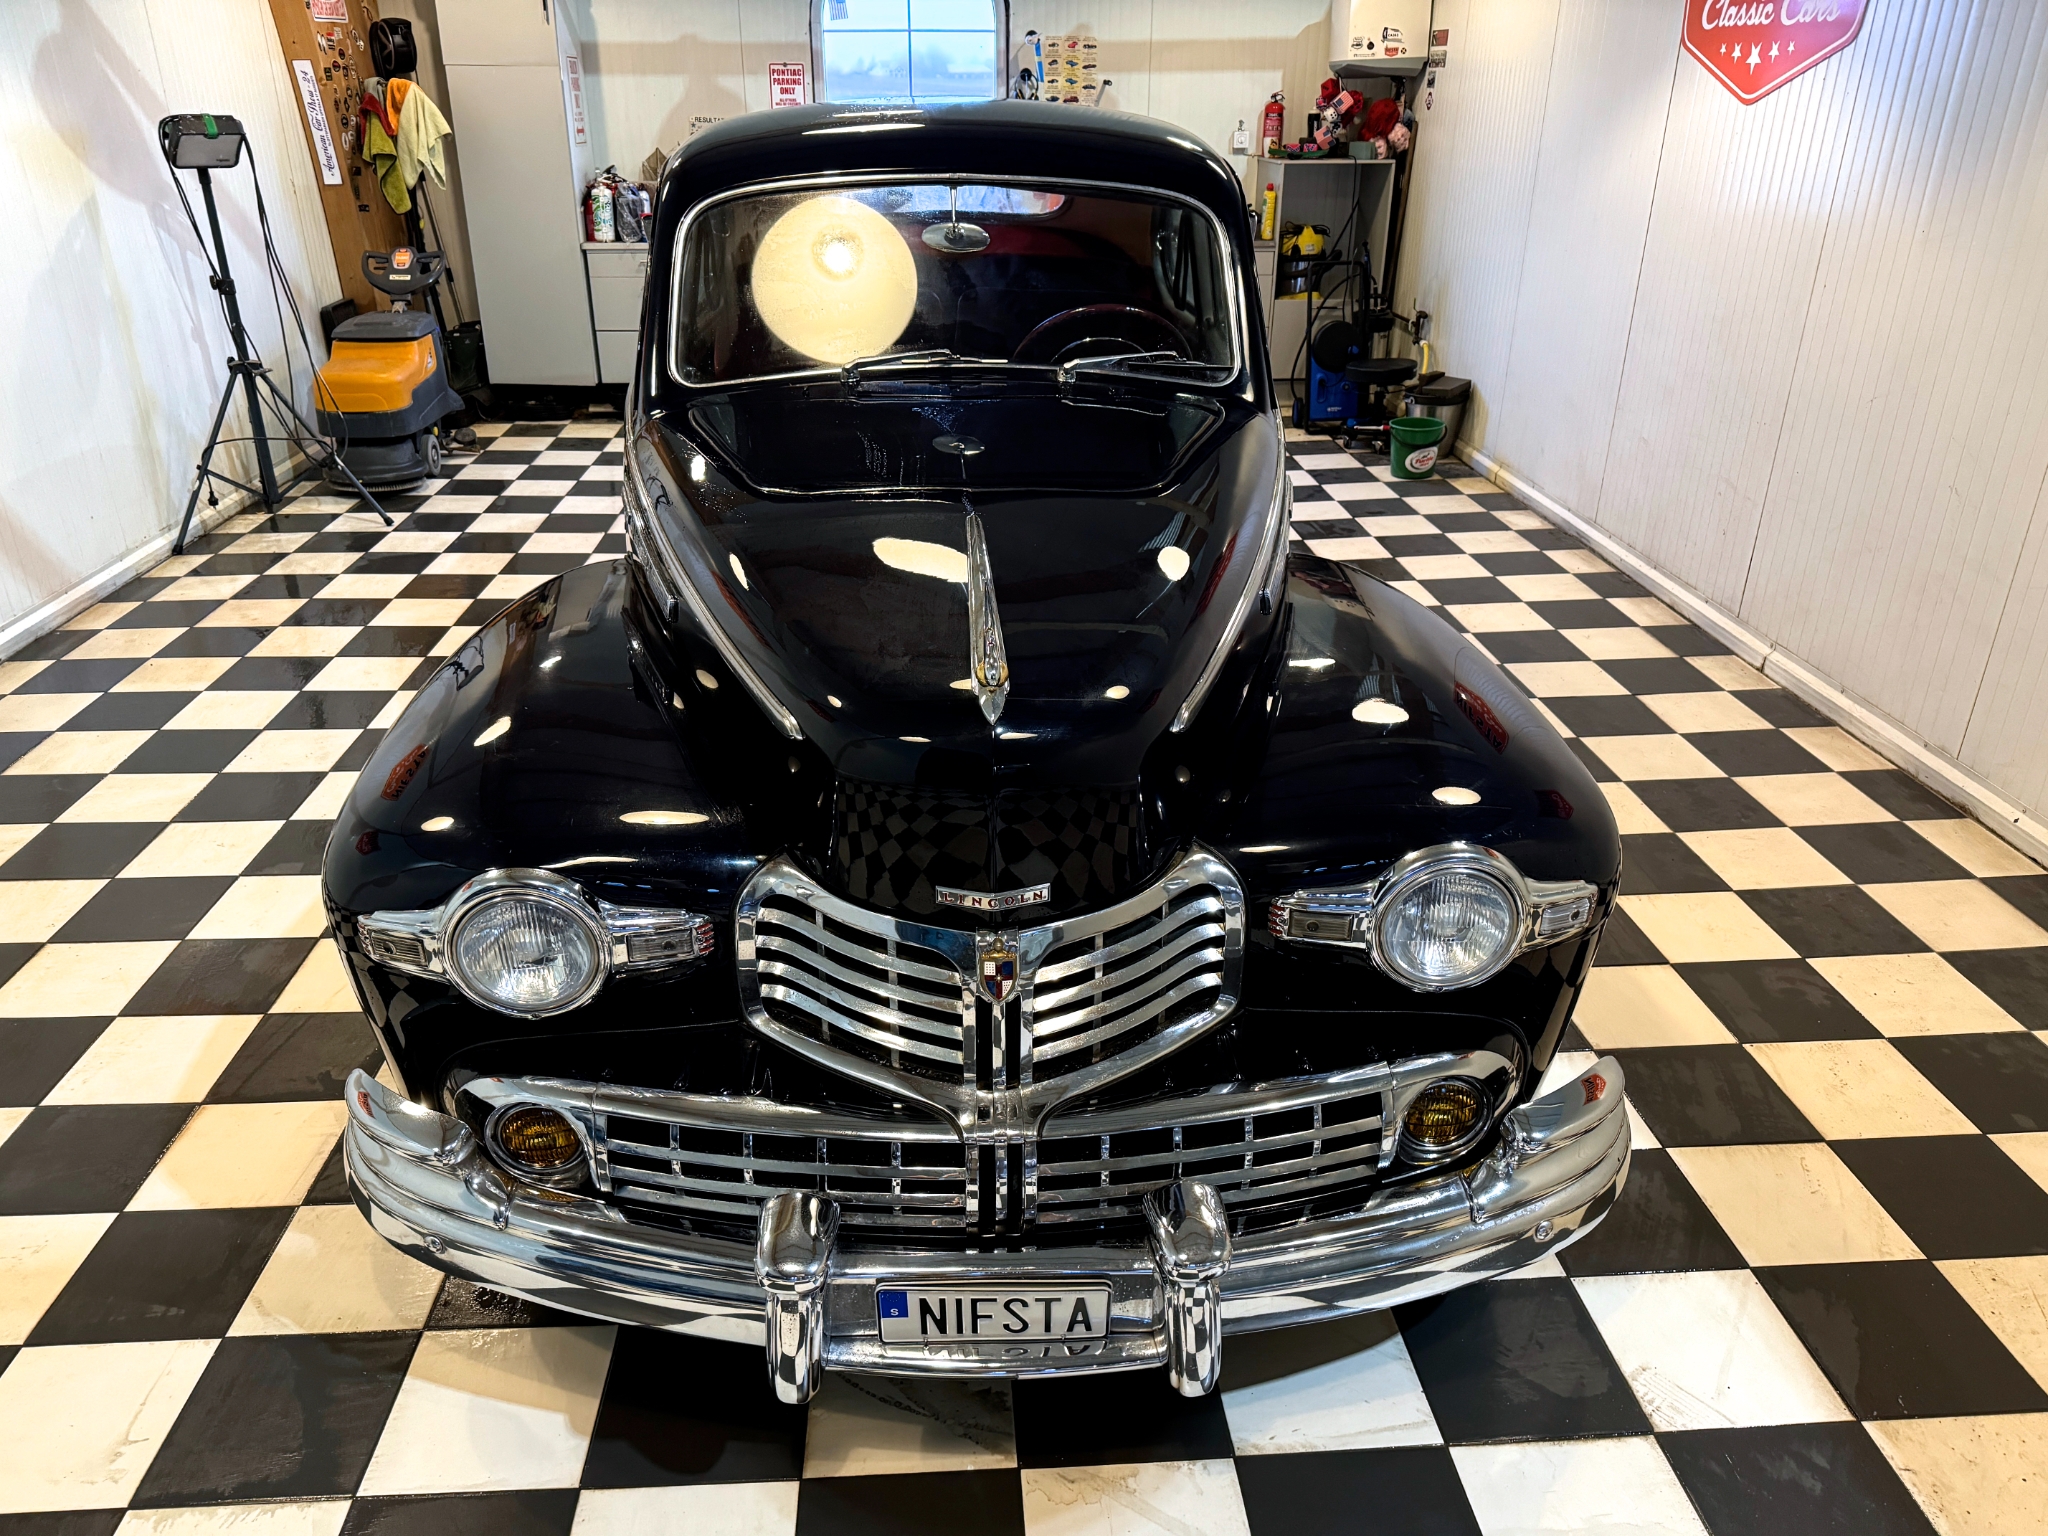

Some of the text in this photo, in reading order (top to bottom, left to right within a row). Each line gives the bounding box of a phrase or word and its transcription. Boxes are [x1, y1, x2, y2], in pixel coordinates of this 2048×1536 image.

[1702, 0, 1840, 30] Classic Cars
[300, 70, 311, 83] 24
[307, 89, 318, 116] Show
[310, 113, 323, 131] Car
[320, 134, 335, 176] American
[943, 890, 1046, 908] LINCOLN
[890, 1308, 899, 1316] S
[918, 1297, 1092, 1335] NIFSTA
